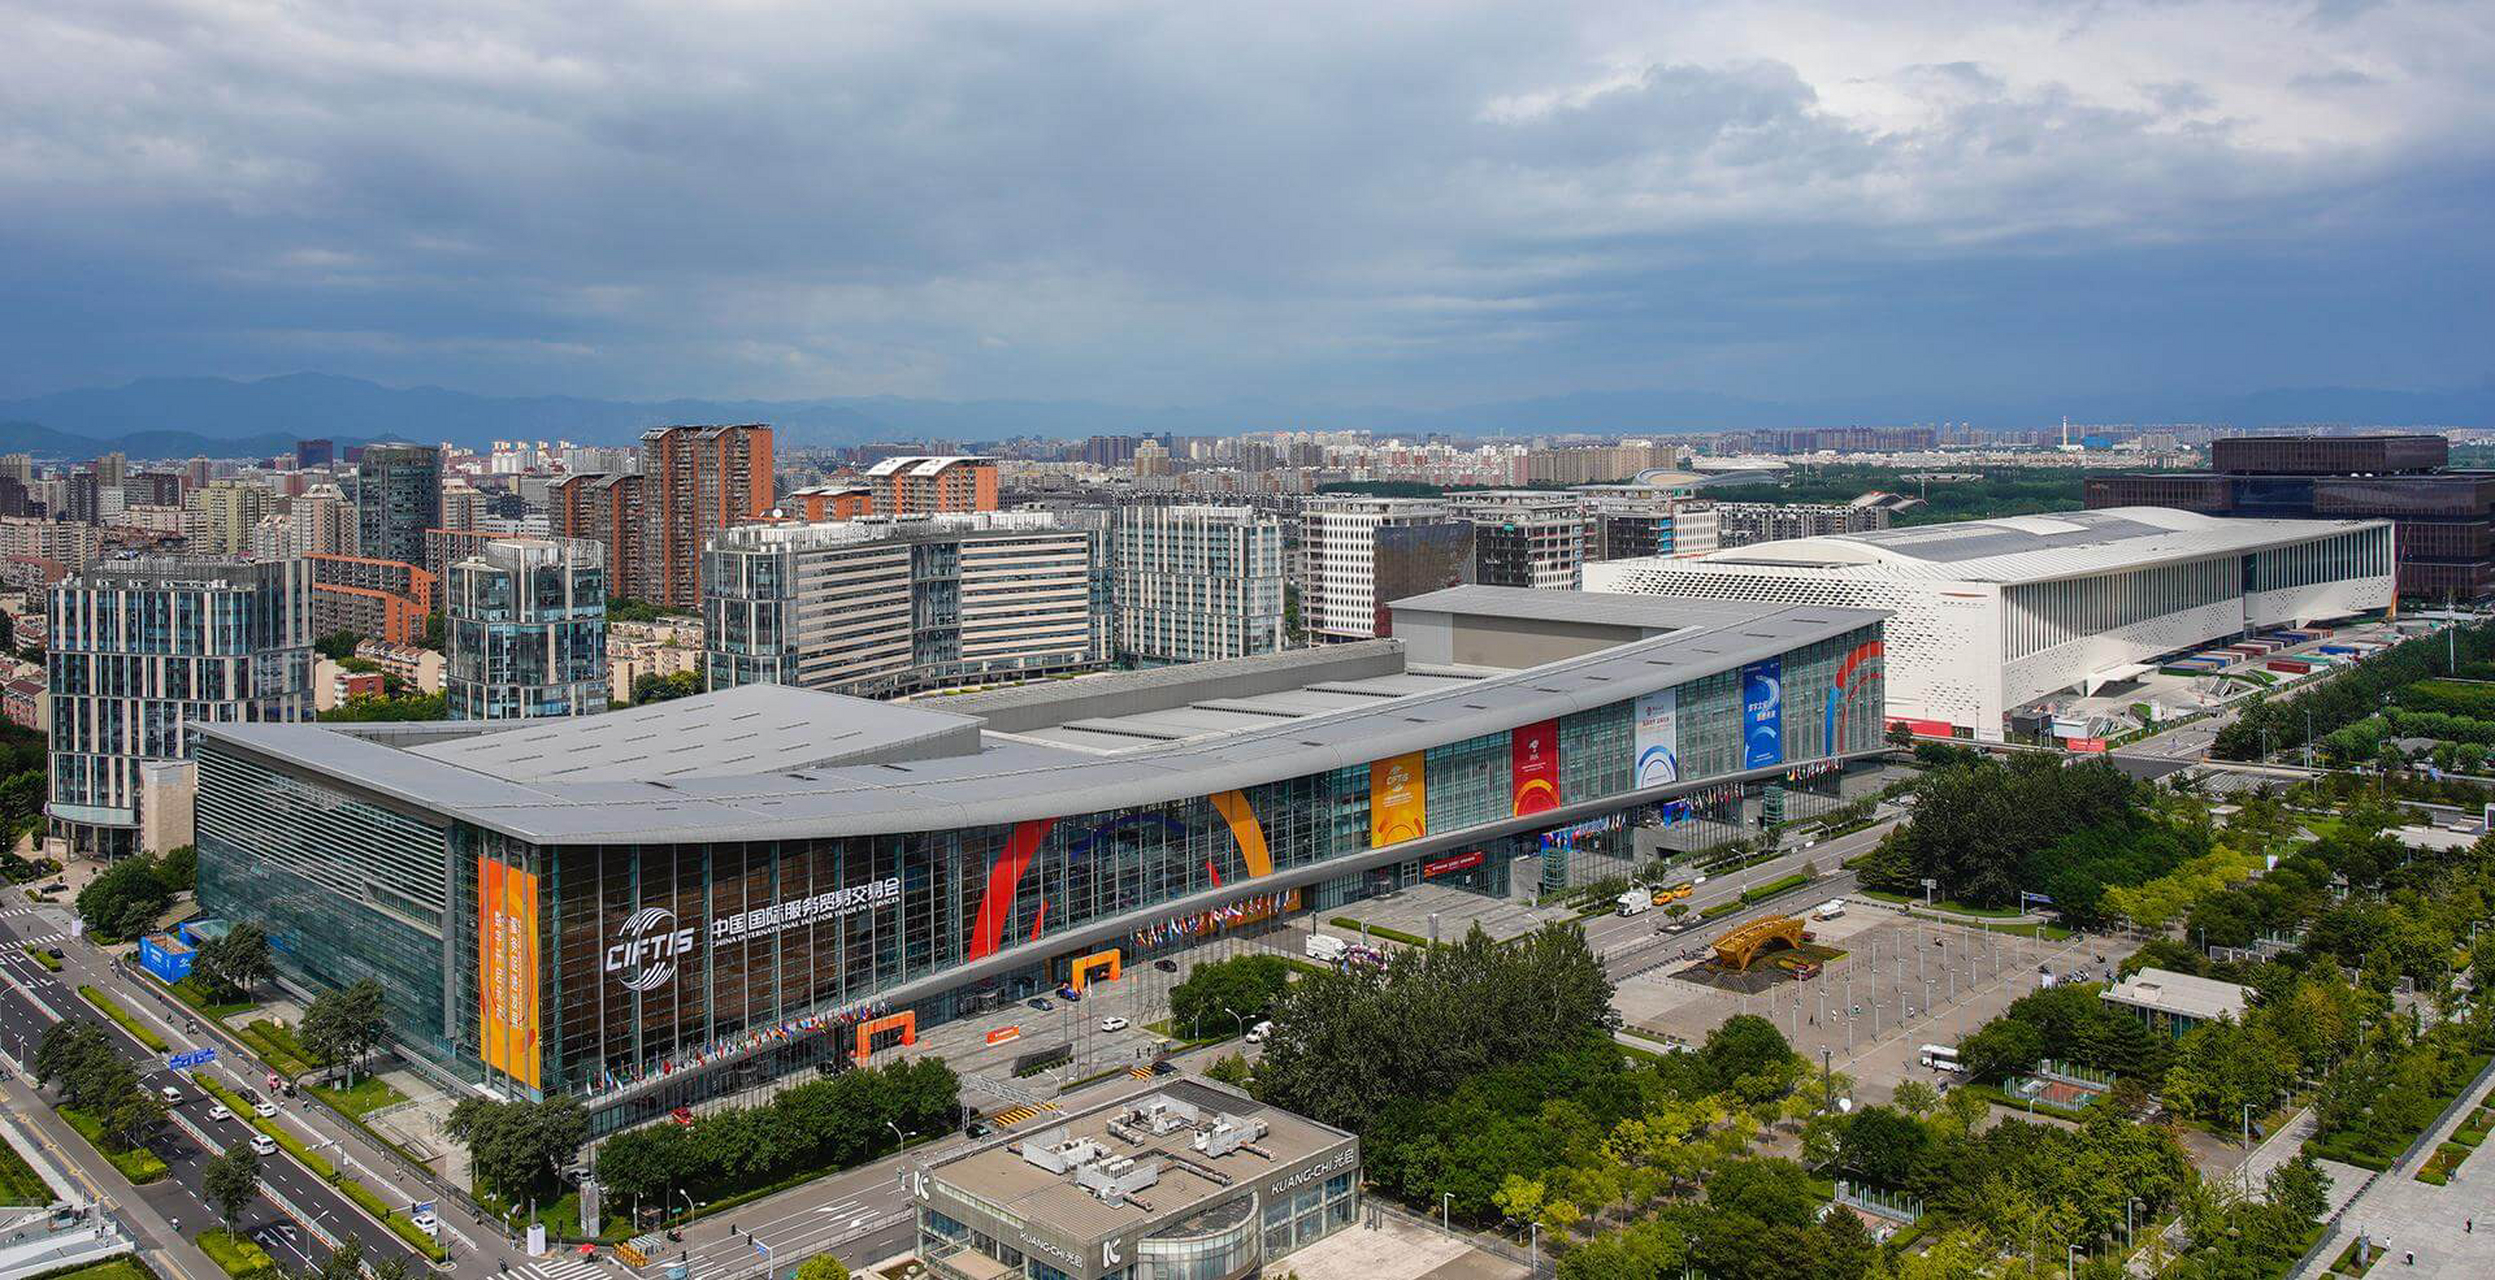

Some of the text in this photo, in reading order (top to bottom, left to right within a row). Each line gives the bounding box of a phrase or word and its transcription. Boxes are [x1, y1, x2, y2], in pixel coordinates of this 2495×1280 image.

[711, 877, 899, 938] 中国国际服务贸易交易会
[801, 914, 818, 926] FAR
[868, 895, 900, 908] SRVICES
[606, 927, 694, 971] CIFTIS
[1271, 1160, 1332, 1196] KUANG-CHI
[1019, 1231, 1066, 1260] KUANG-CHI
